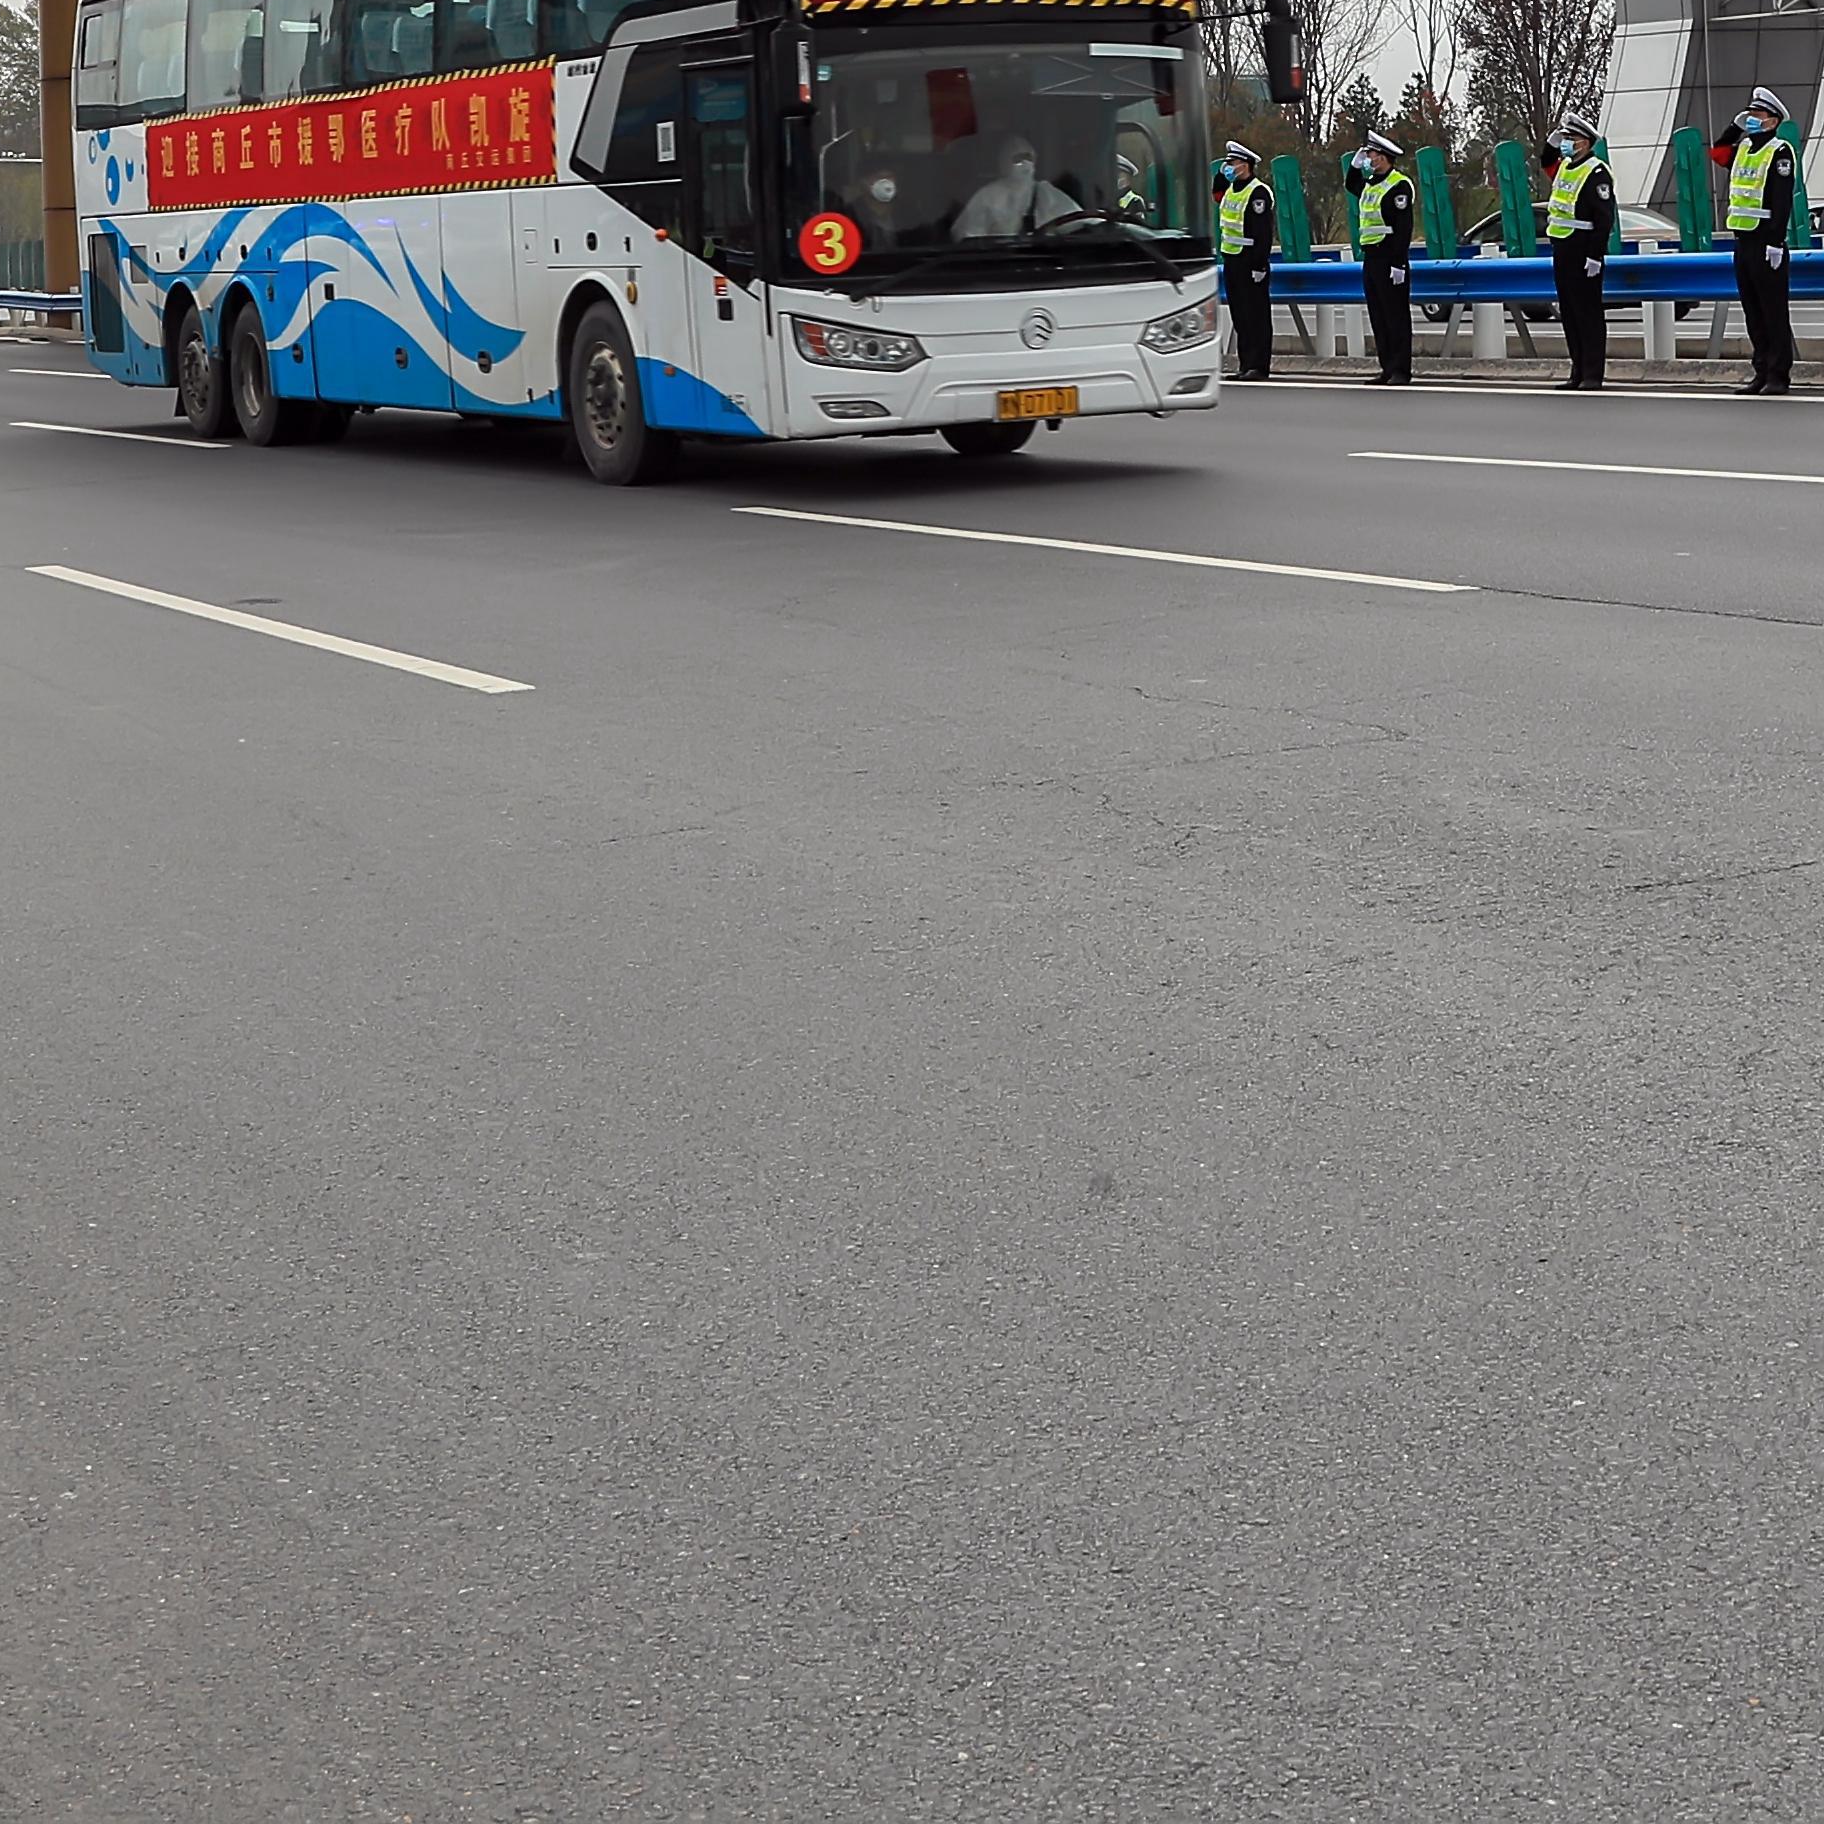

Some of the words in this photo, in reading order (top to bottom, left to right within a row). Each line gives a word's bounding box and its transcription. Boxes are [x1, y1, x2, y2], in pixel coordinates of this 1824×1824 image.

[160, 86, 531, 177] 迎接商丘市援鄂医疗队凯旋
[812, 221, 847, 267] 3
